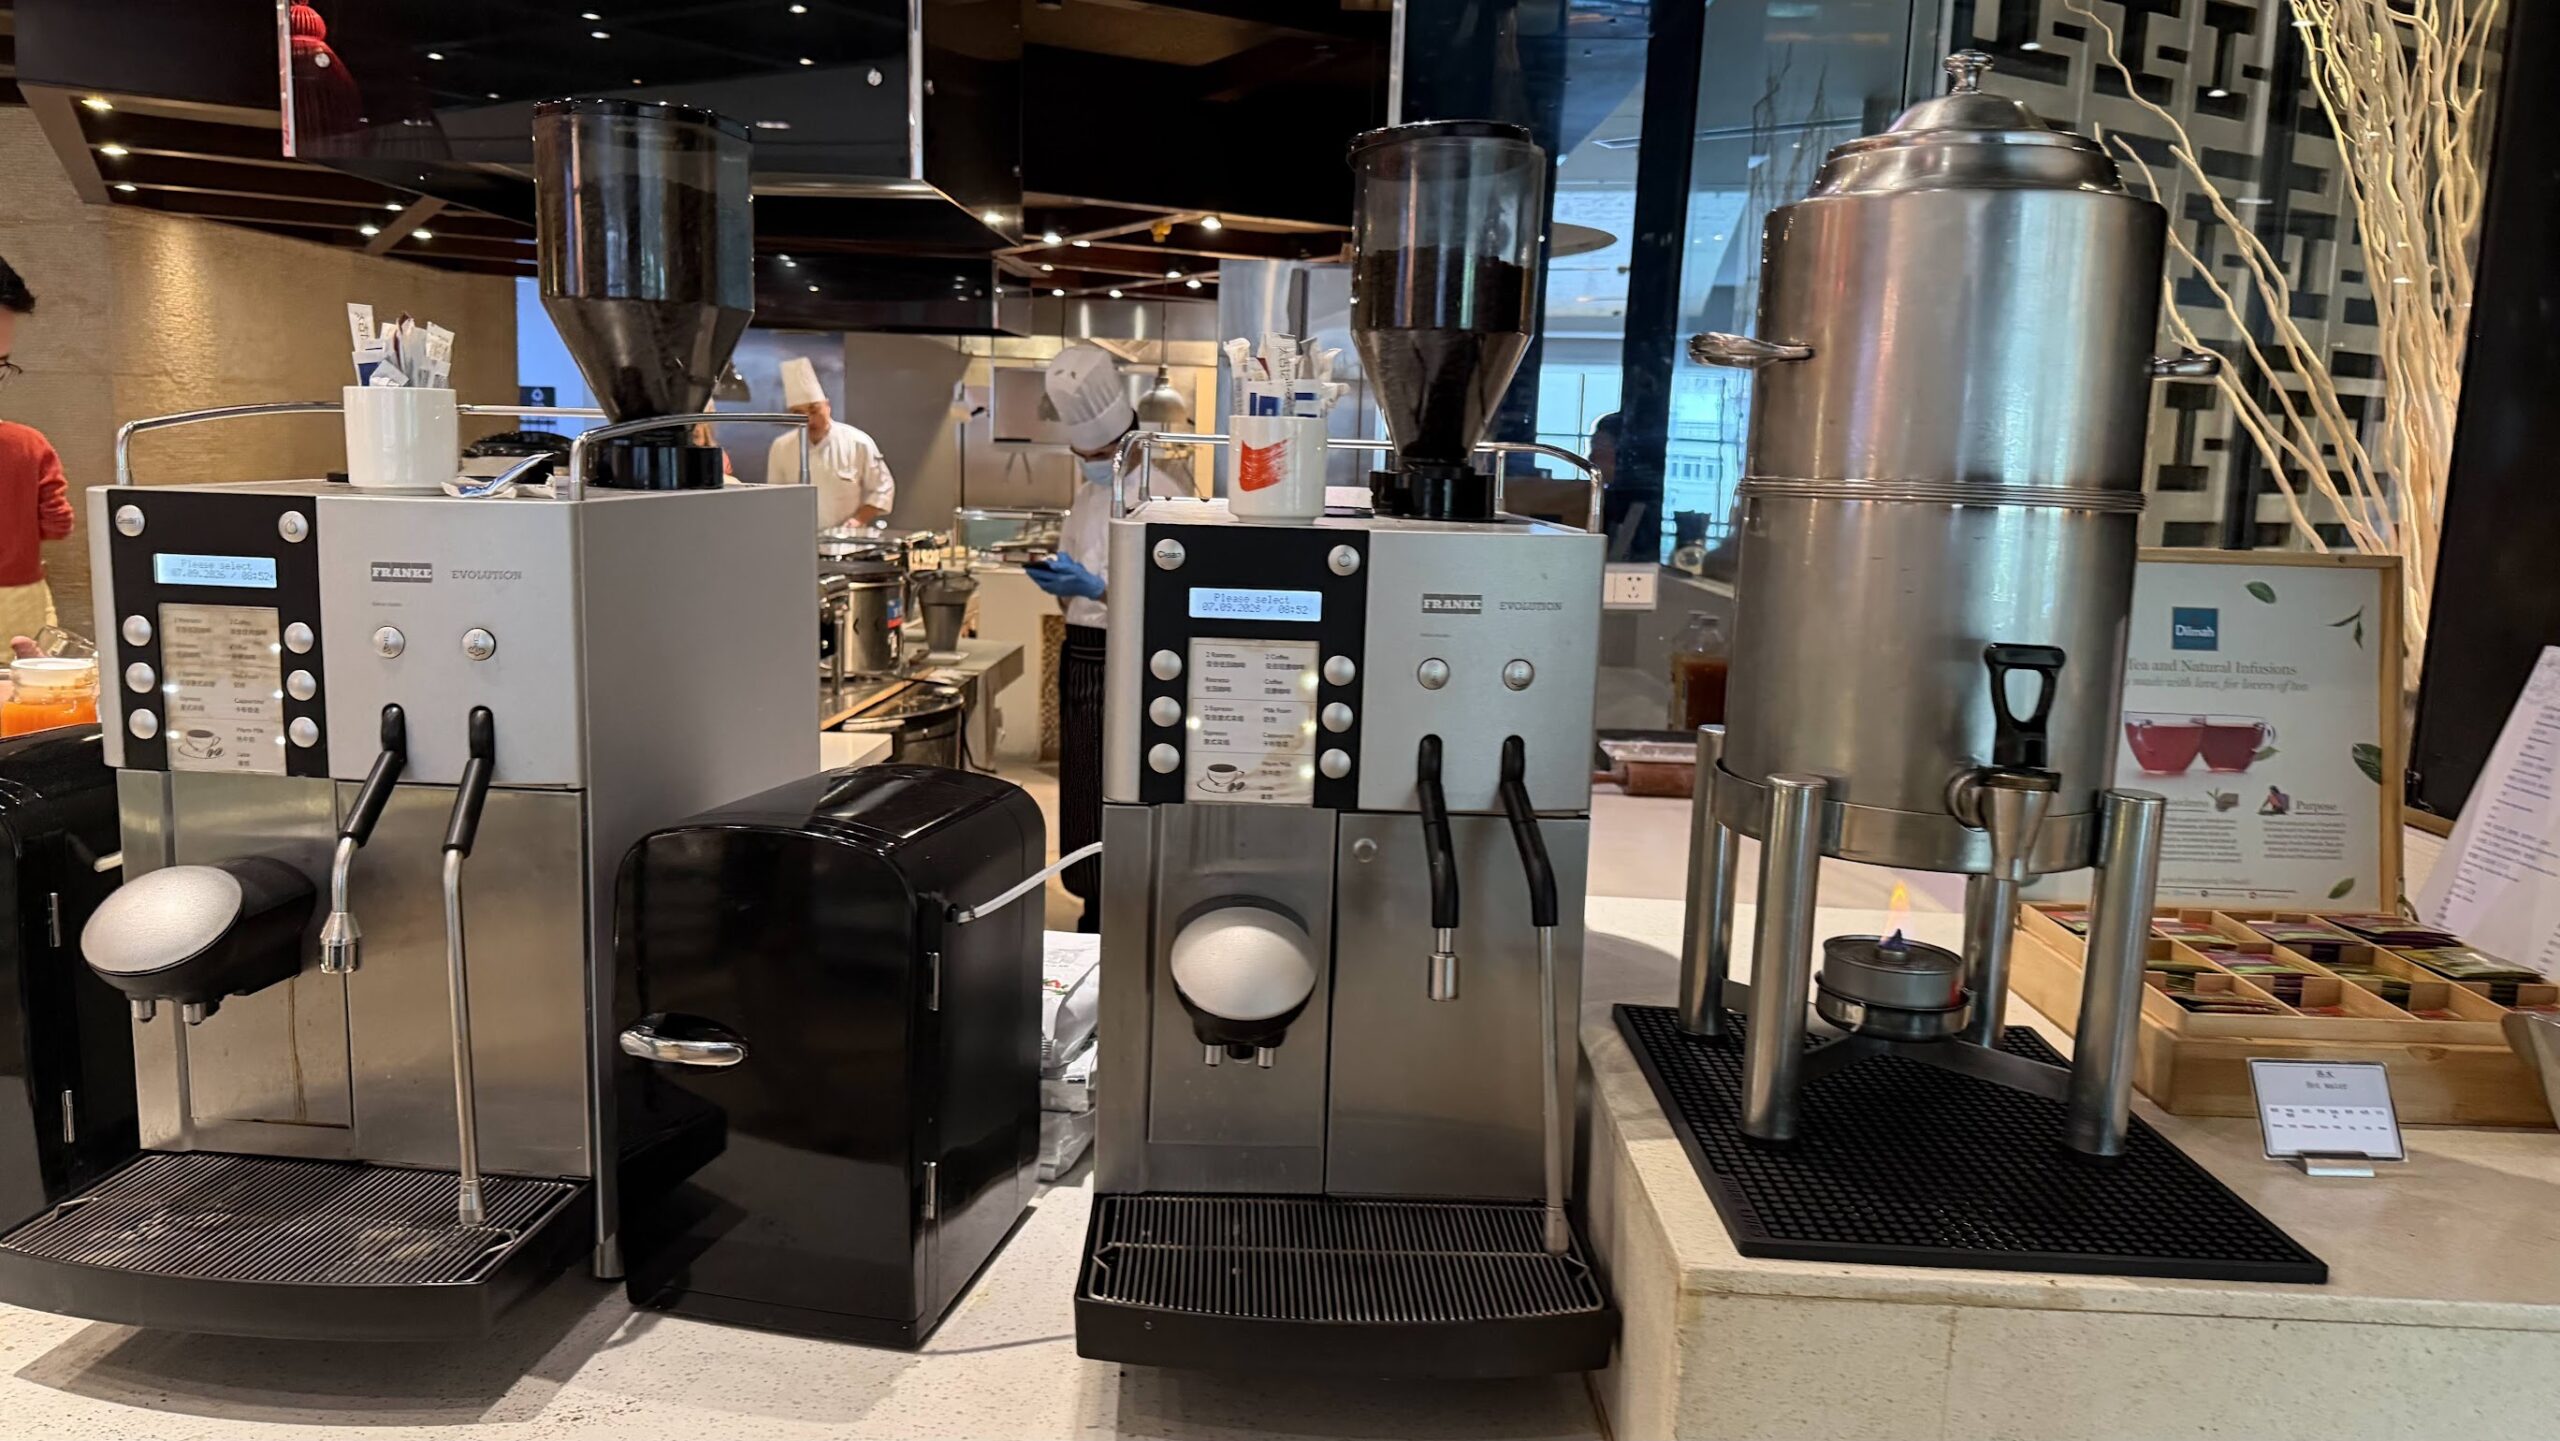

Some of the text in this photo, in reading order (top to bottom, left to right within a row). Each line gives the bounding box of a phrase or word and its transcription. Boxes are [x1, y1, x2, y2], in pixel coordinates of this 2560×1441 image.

[181, 559, 253, 571] Please select
[371, 566, 433, 579] FRANKE
[452, 569, 523, 581] EVOLUTION
[1214, 593, 1290, 605] Please select
[1423, 599, 1483, 610] FRANKE
[1278, 605, 1309, 615] 08:52
[1499, 601, 1563, 611] EVOLUTION
[2174, 624, 2216, 638] Dilmah
[2151, 659, 2177, 672] and
[2181, 660, 2232, 674] Natural
[2236, 661, 2297, 675] Infusions
[2296, 800, 2338, 812] Purpose
